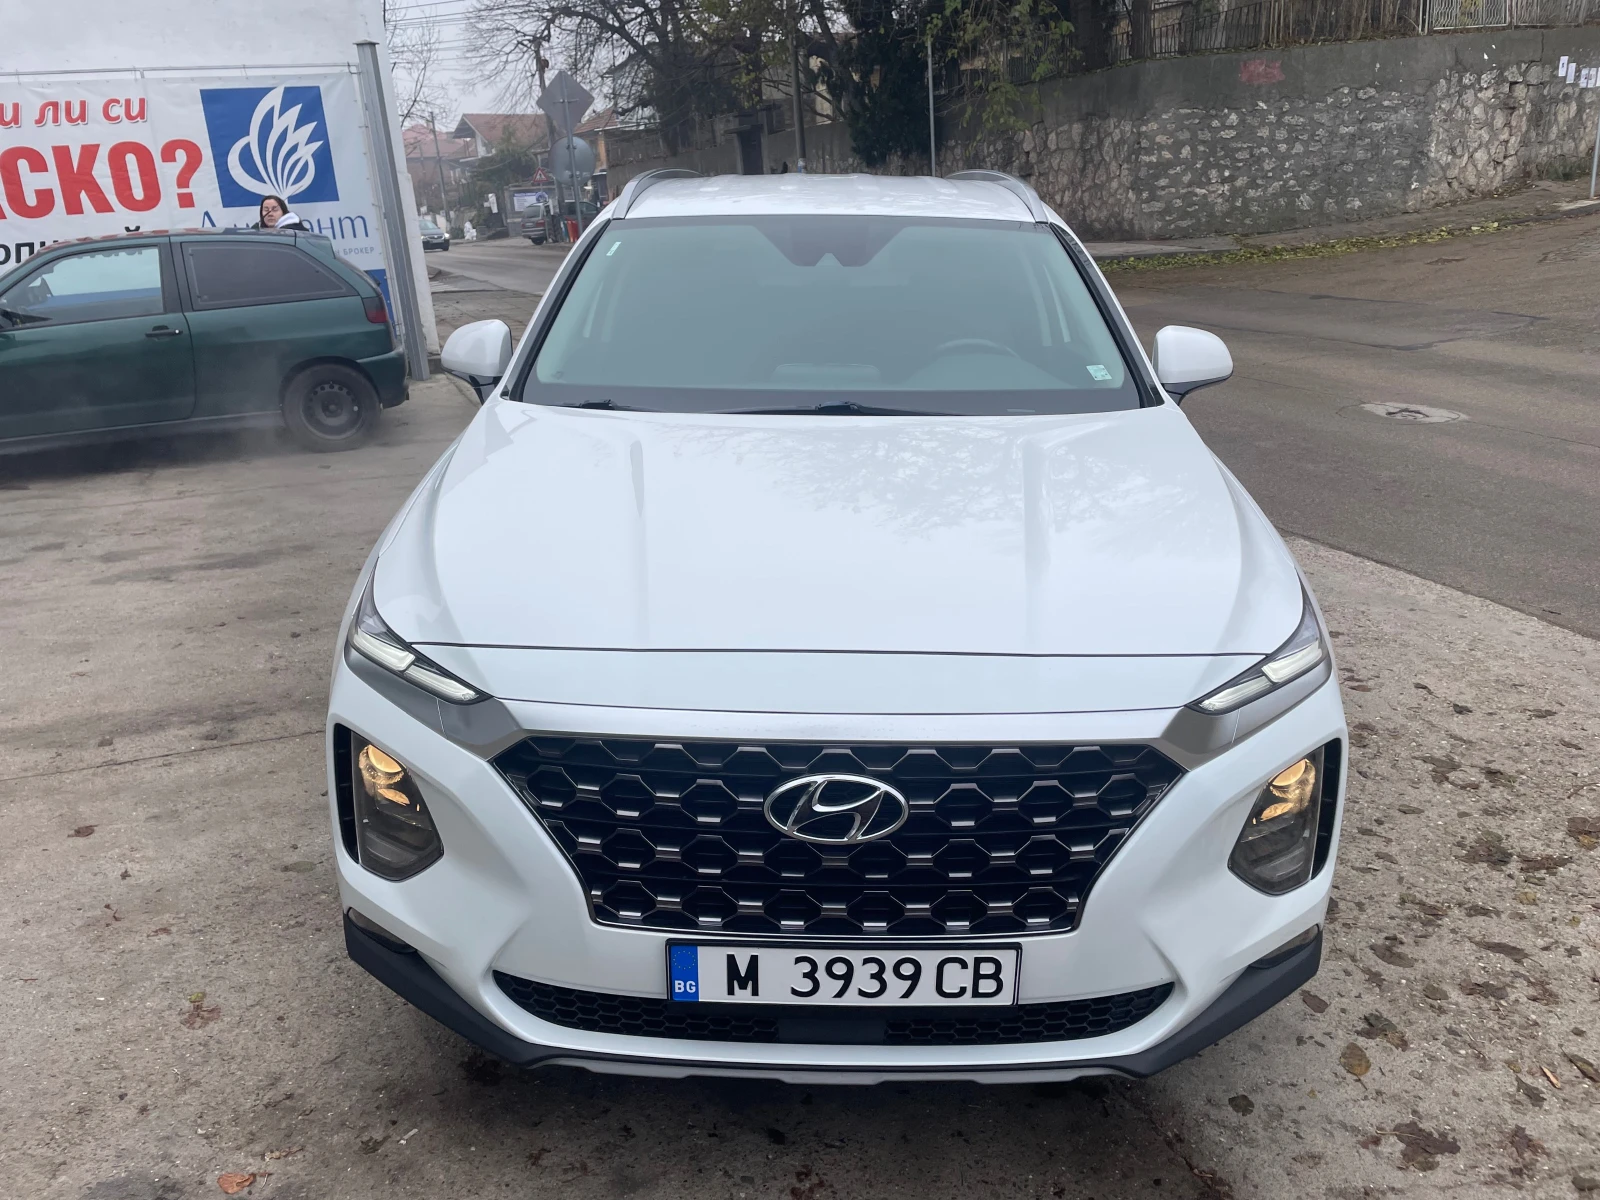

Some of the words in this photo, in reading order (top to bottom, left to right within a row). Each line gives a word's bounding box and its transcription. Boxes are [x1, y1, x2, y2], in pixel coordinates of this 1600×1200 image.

[34, 99, 88, 126] ли
[102, 96, 147, 123] си
[0, 138, 203, 220] СКО?
[343, 246, 375, 256] БРОКЕР
[674, 980, 696, 993] BG
[726, 953, 760, 997] M
[790, 955, 922, 999] 3939
[935, 956, 1004, 999] CB
